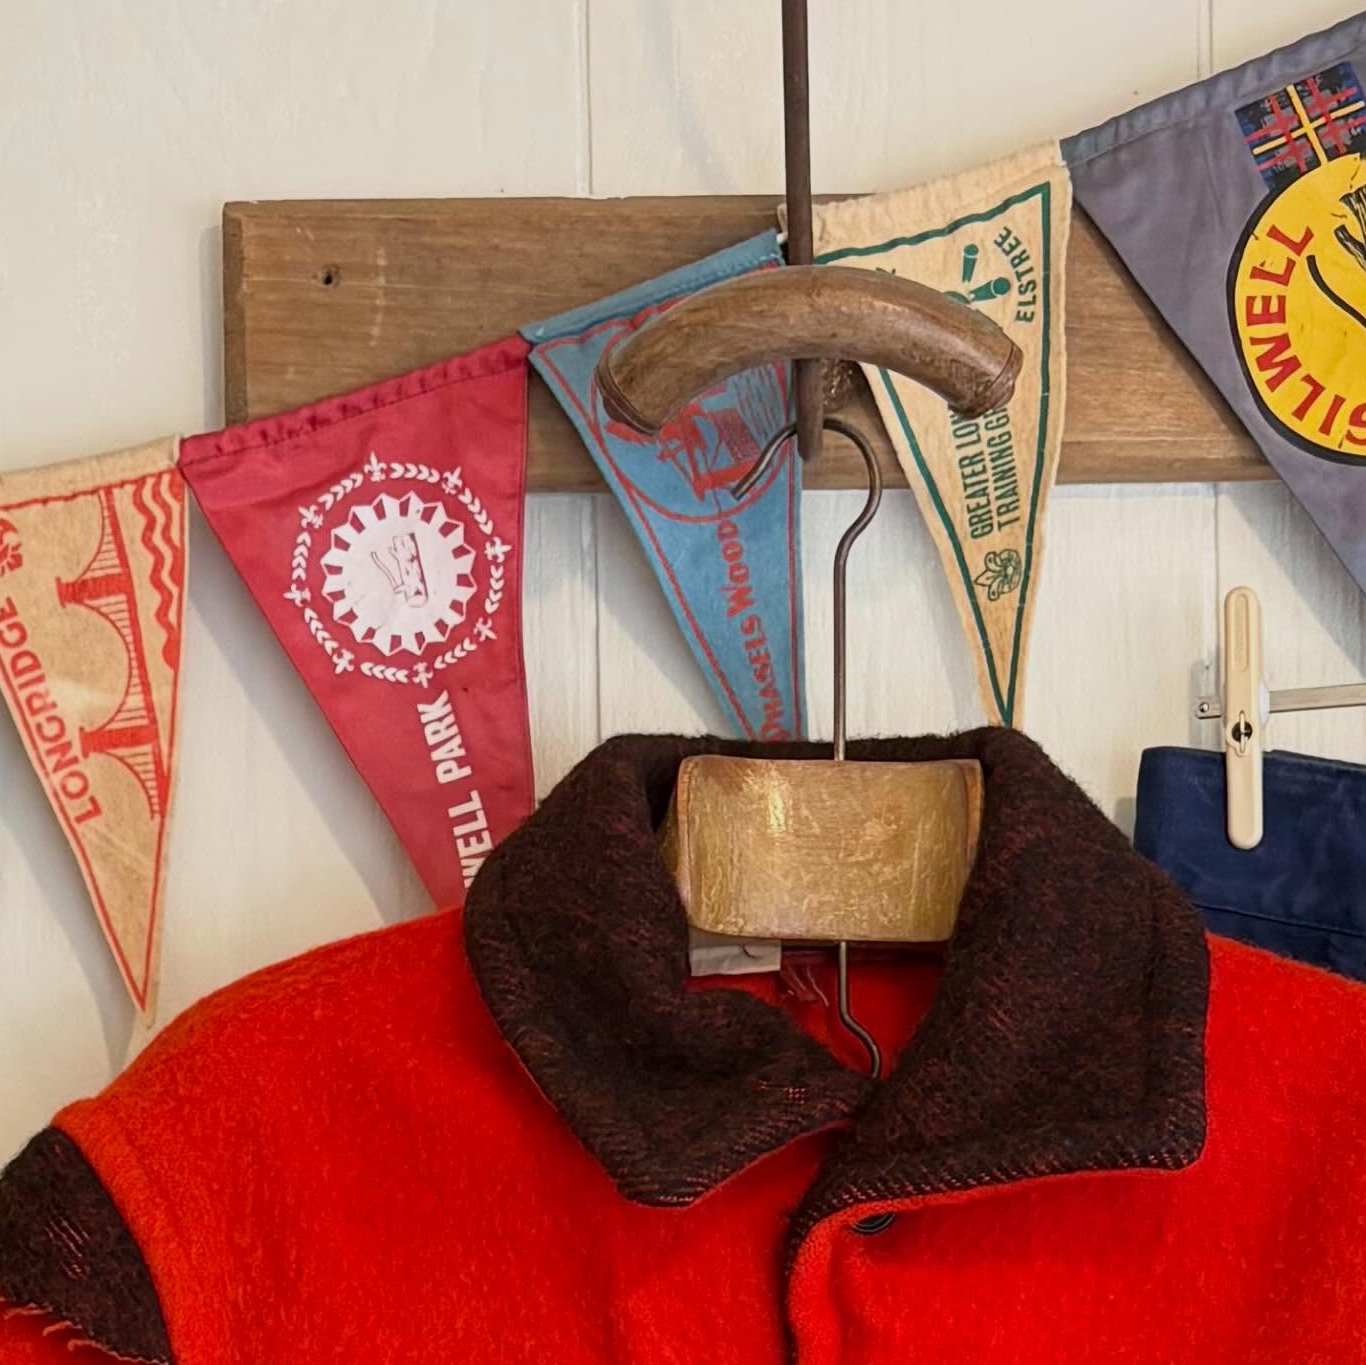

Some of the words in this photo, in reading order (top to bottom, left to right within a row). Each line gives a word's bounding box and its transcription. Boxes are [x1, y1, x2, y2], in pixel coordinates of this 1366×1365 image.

[993, 226, 1037, 323] ELSTREE
[958, 447, 994, 540] GREATER
[987, 433, 1021, 534] TRAINING
[417, 690, 473, 784] PARK
